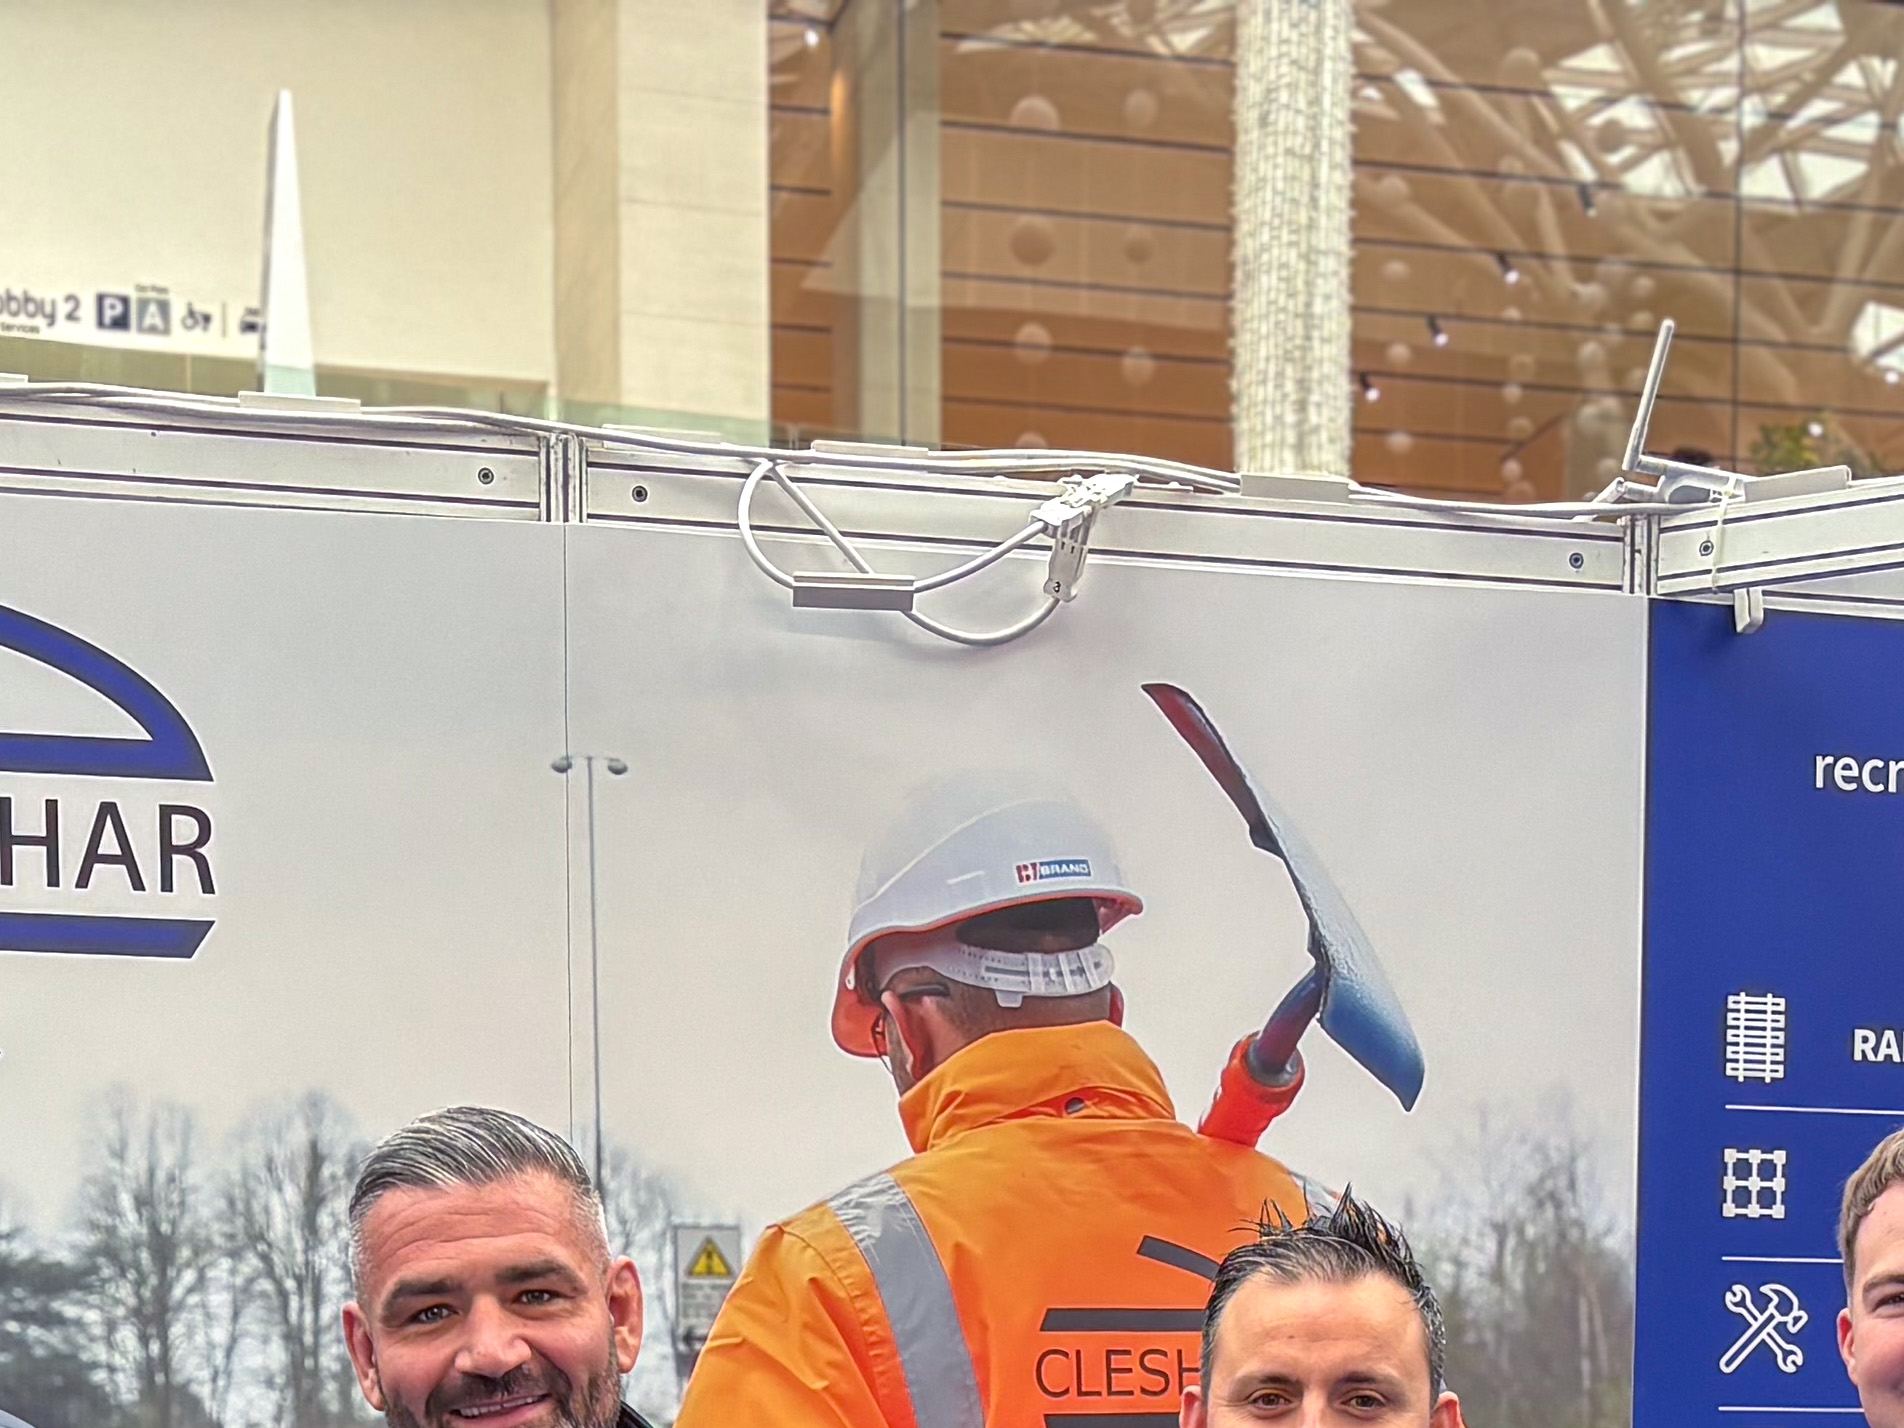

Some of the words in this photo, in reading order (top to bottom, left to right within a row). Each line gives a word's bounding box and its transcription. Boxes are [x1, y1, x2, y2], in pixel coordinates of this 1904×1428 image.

[64, 294, 81, 322] 2
[103, 299, 124, 325] P
[0, 322, 40, 335] Services
[1040, 863, 1089, 876] BRAND
[1035, 1348, 1200, 1399] CLESH
